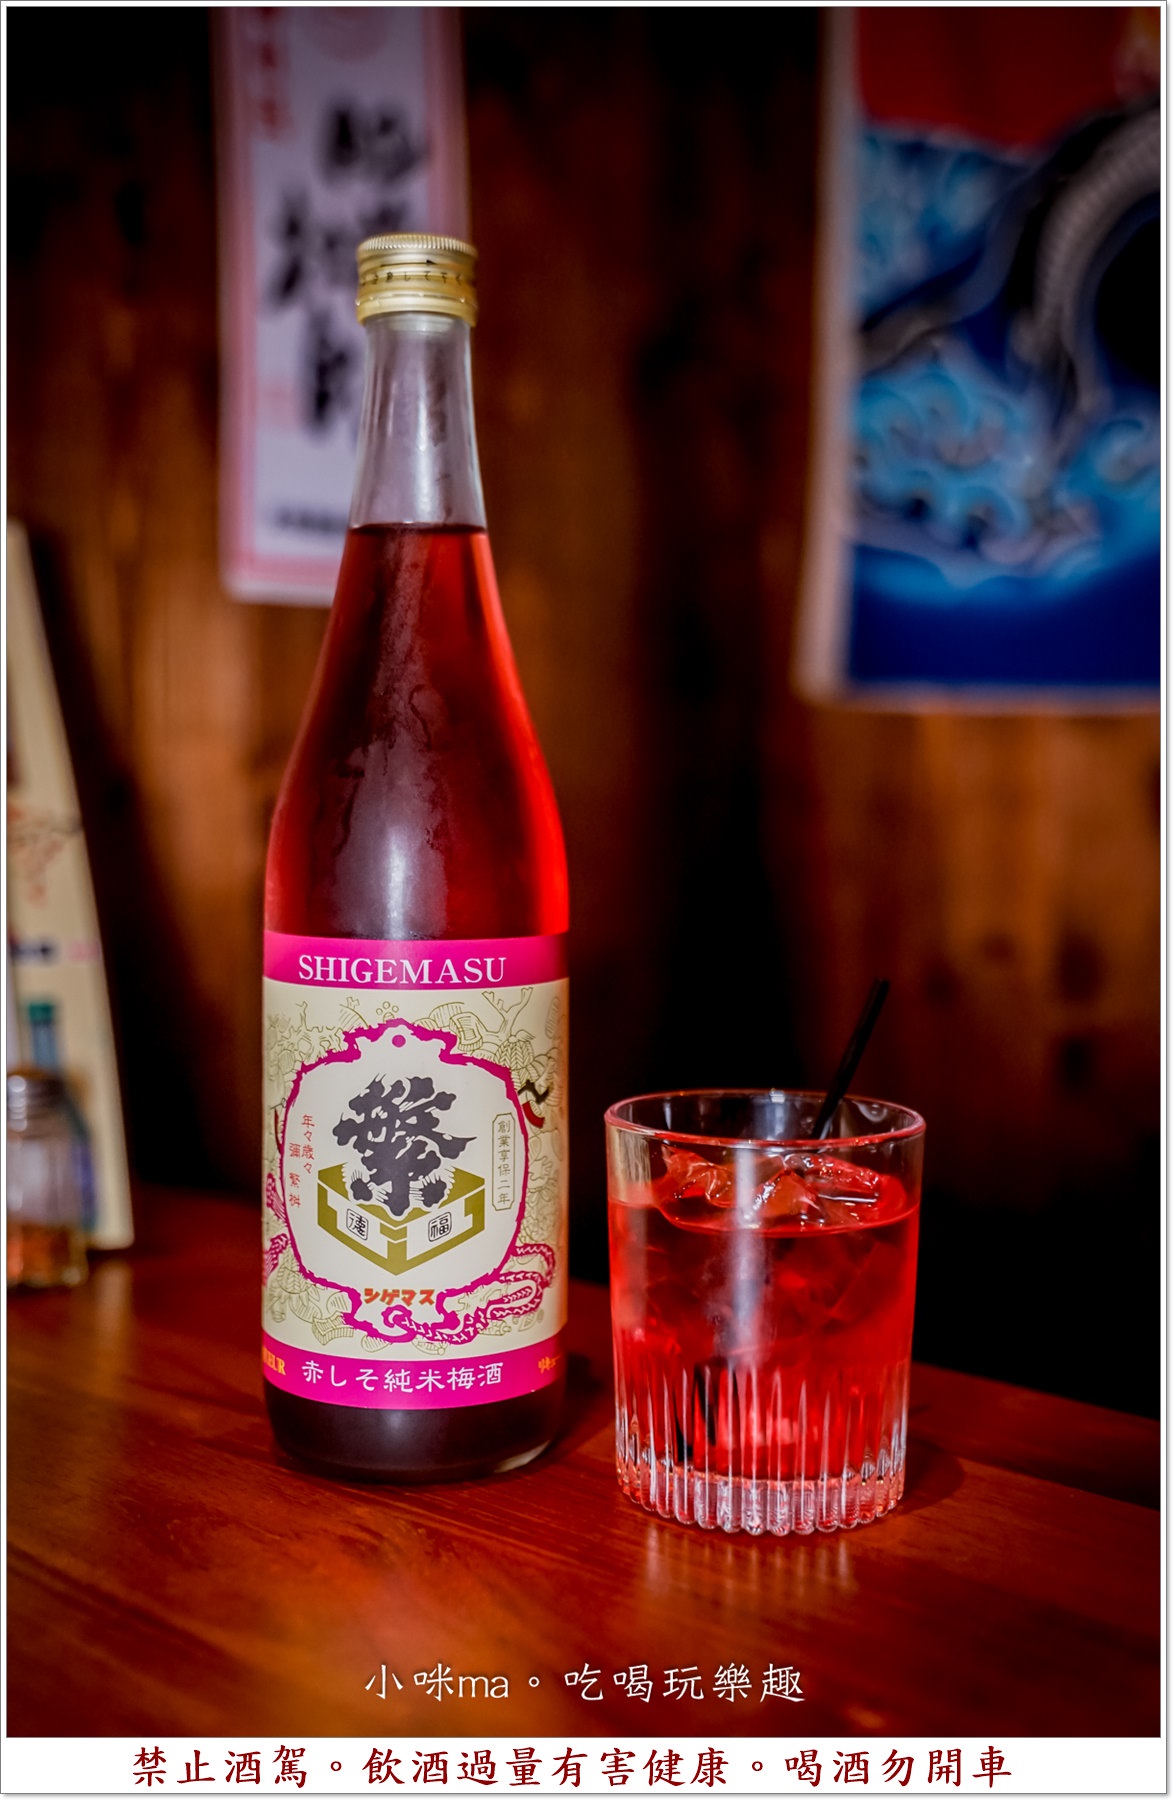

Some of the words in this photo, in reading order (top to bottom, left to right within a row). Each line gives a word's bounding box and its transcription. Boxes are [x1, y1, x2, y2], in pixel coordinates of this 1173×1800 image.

[298, 954, 507, 985] SHIGEMASU
[497, 1120, 511, 1205] 創業享保二年
[363, 1287, 436, 1307] シゲマス
[301, 1359, 504, 1393] 赤しそ純米梅酒
